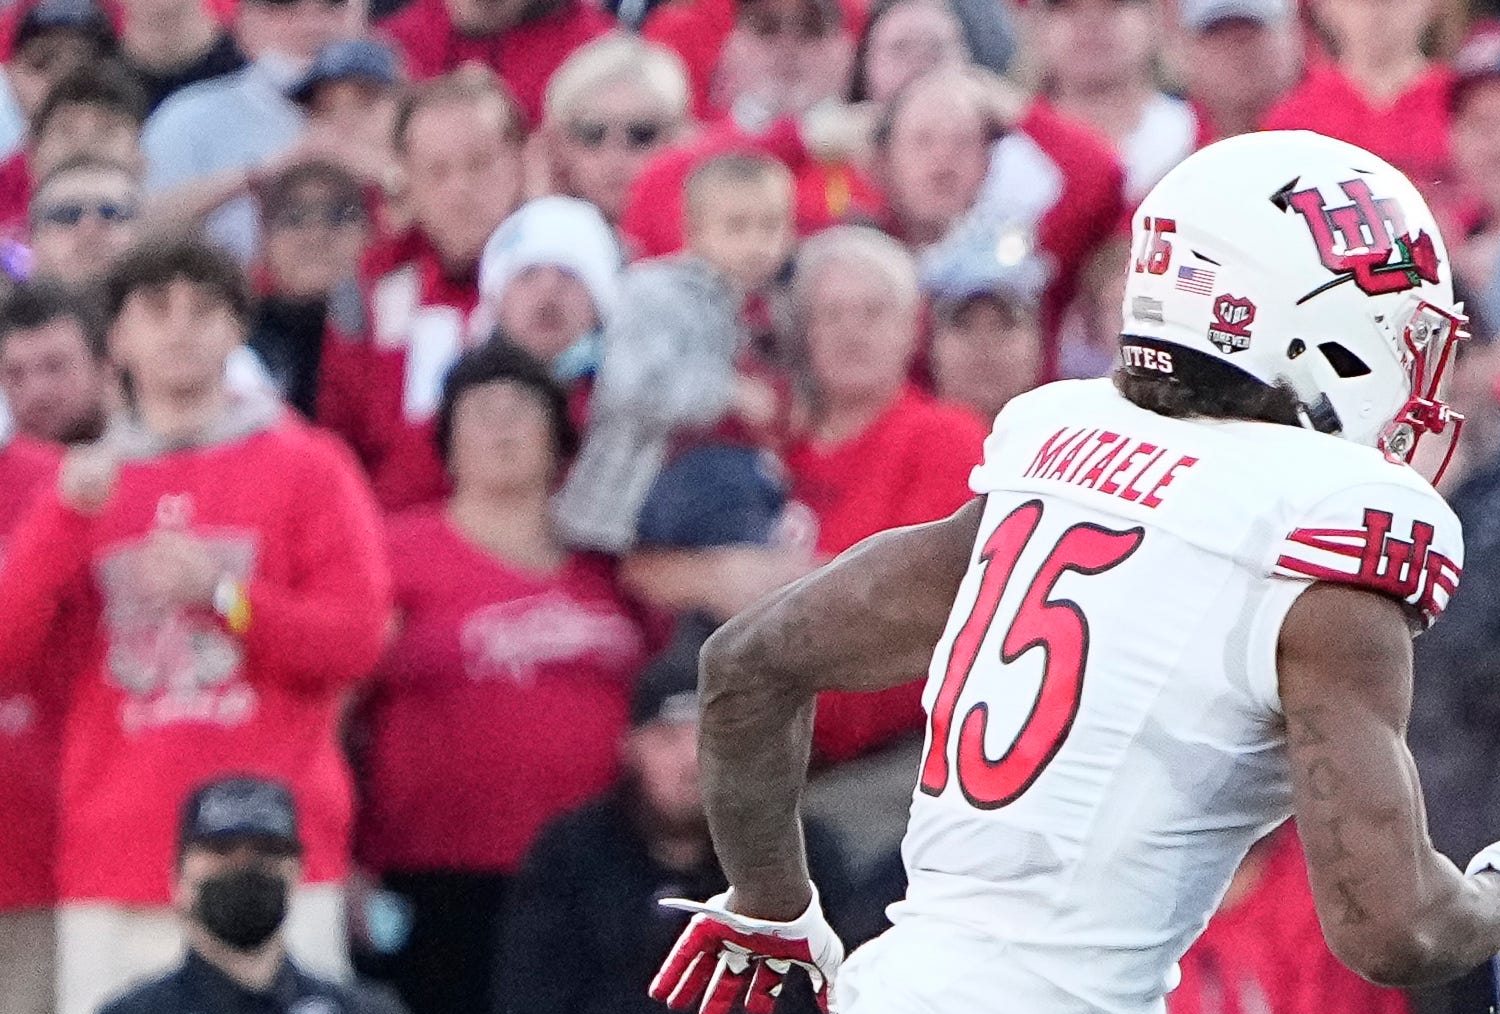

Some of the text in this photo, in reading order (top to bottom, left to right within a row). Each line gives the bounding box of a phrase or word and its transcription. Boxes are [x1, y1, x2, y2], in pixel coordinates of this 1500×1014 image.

[1135, 216, 1176, 275] 15
[1023, 426, 1200, 509] MATAELE
[919, 498, 1146, 811] 15
